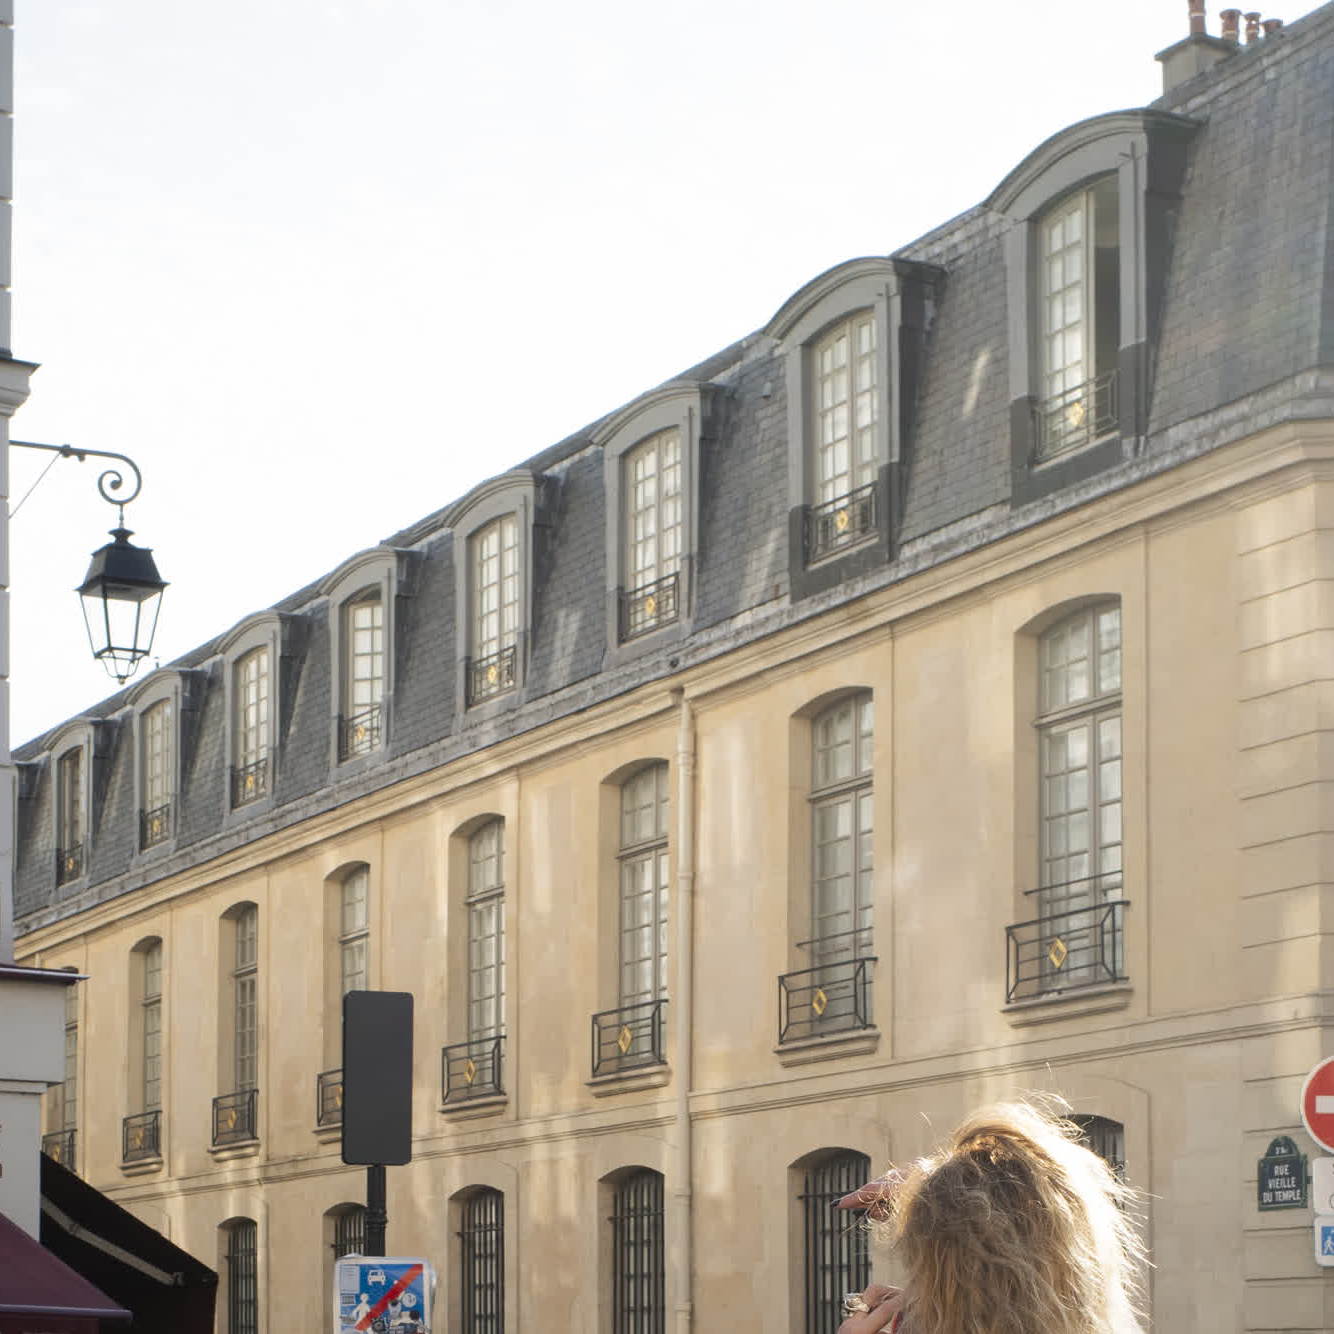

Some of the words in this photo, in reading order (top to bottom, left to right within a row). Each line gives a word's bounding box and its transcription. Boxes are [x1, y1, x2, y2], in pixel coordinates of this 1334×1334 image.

[1274, 1164, 1289, 1176] RUE
[1268, 1176, 1296, 1189] VIEILLE
[1263, 1191, 1273, 1203] DU
[1275, 1189, 1301, 1202] TEMPLE
